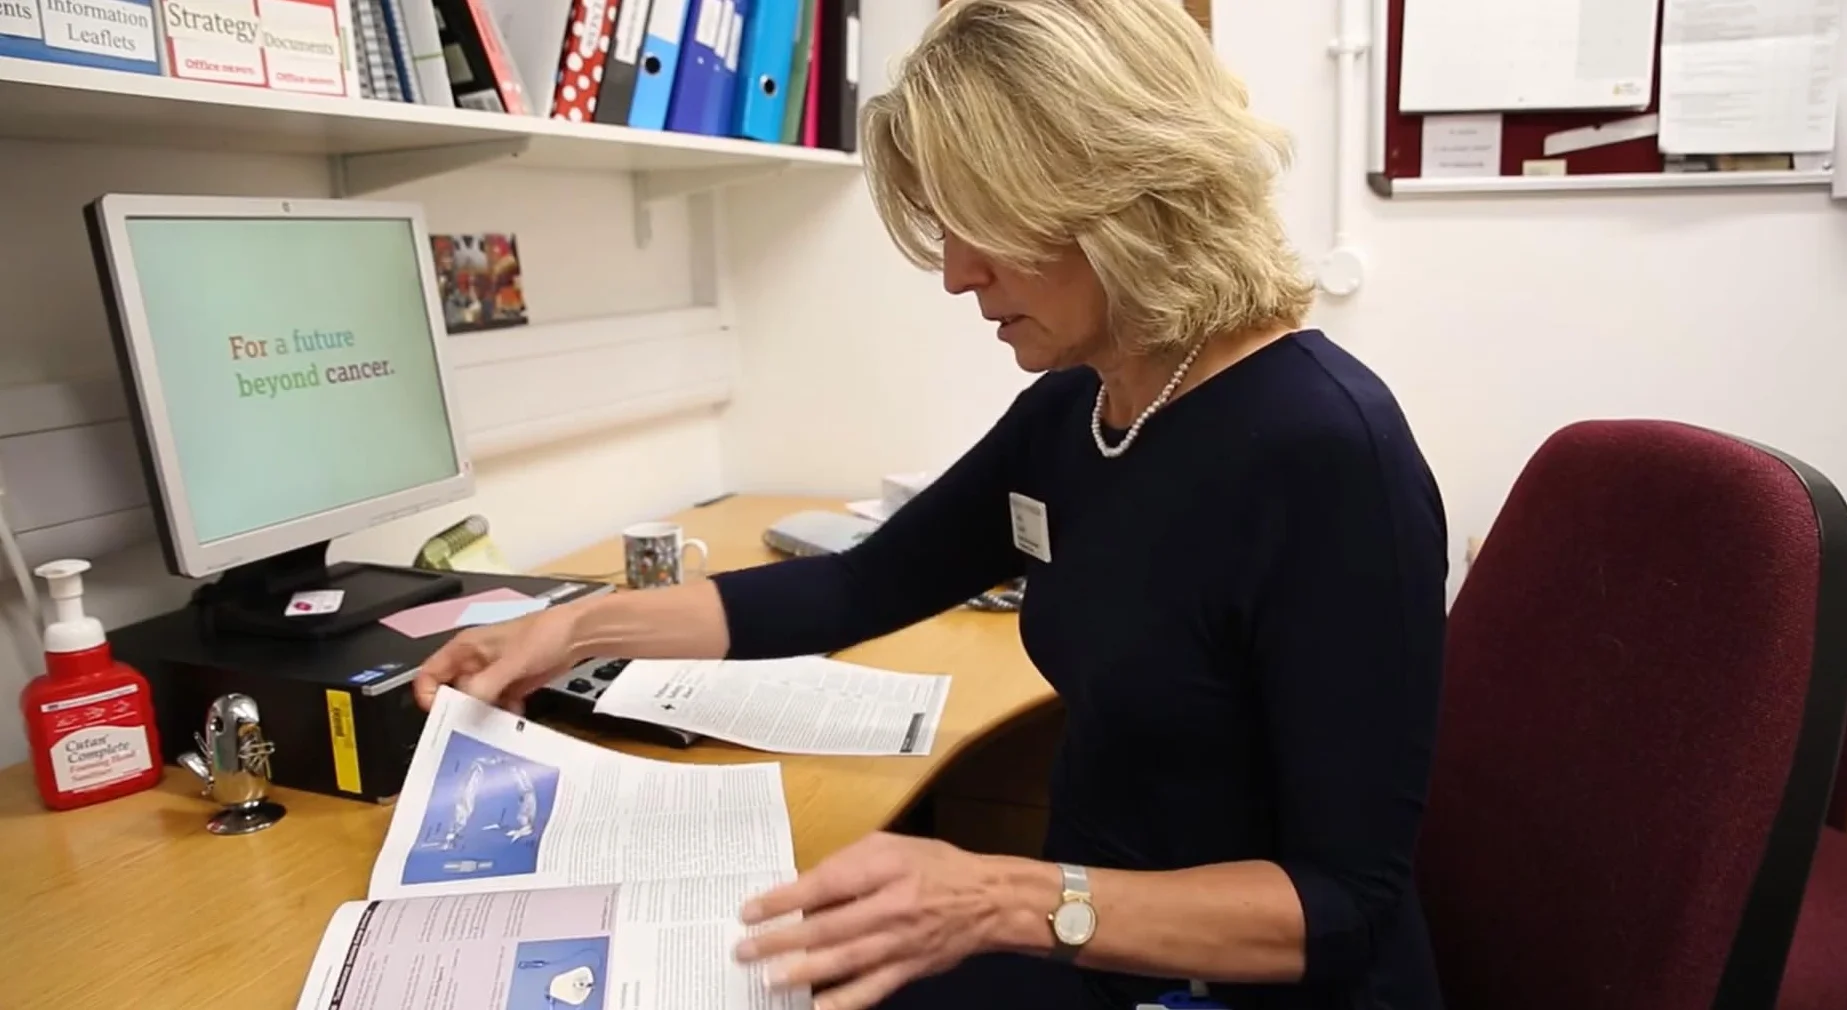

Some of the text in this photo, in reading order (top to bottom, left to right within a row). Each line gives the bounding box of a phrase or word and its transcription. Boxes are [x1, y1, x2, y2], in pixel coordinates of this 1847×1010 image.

[66, 23, 136, 51] Leaflets
[168, 2, 259, 44] Strategy
[263, 32, 334, 55] Documents
[228, 328, 355, 360] For a future
[235, 359, 395, 399] beyond cancer.
[68, 742, 129, 763] Complete
